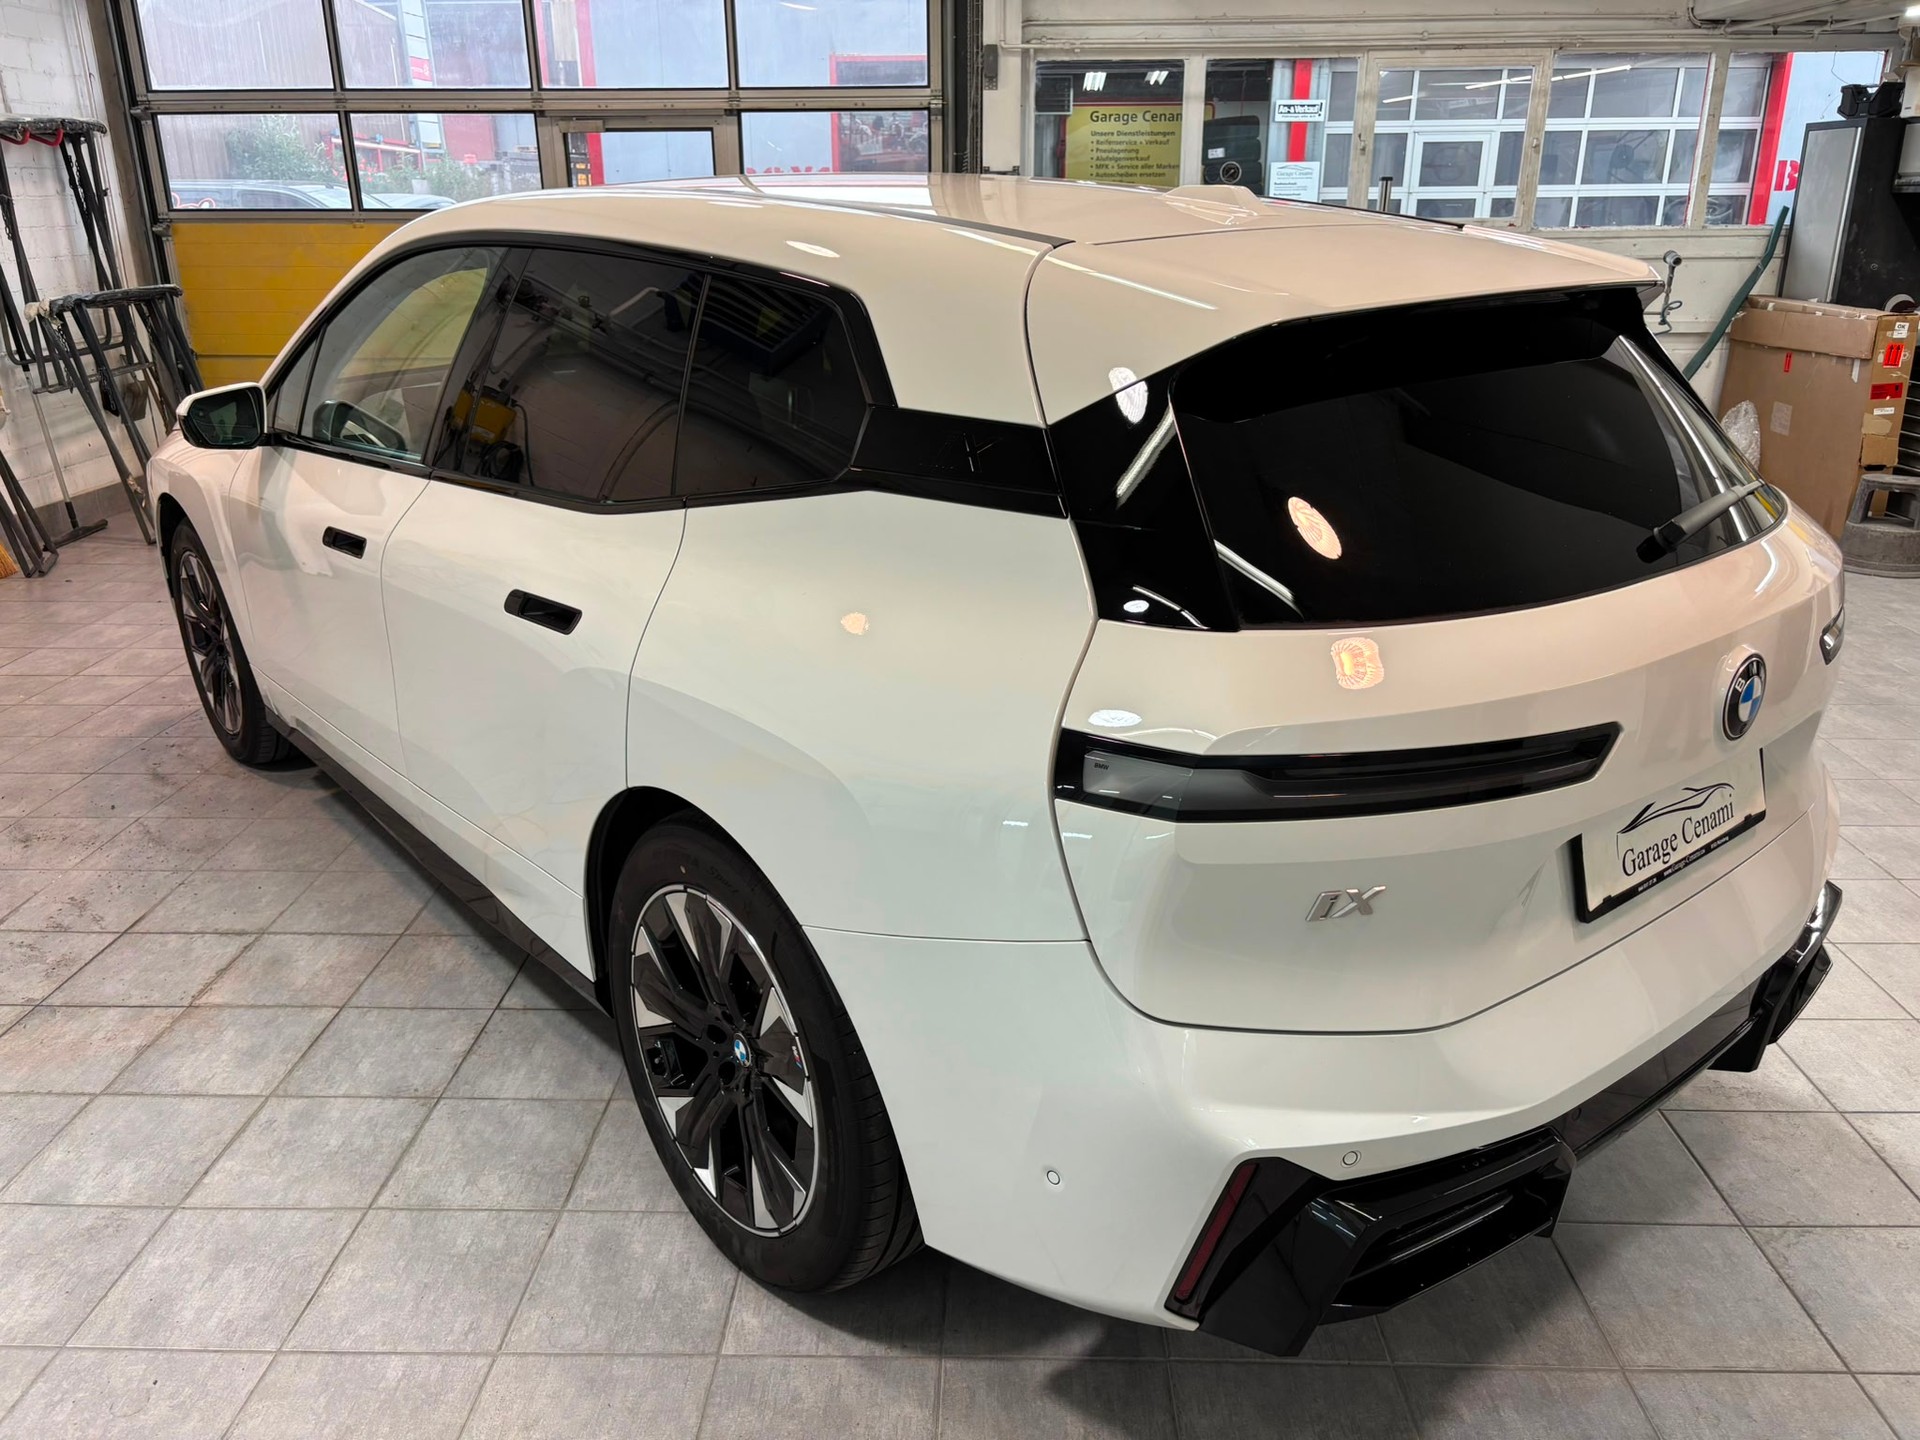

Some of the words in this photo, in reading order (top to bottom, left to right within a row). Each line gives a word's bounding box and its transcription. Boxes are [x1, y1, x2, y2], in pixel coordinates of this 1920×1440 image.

[1090, 110, 1138, 125] Garage
[1621, 832, 1679, 877] Garage
[1681, 793, 1735, 844] Cenami
